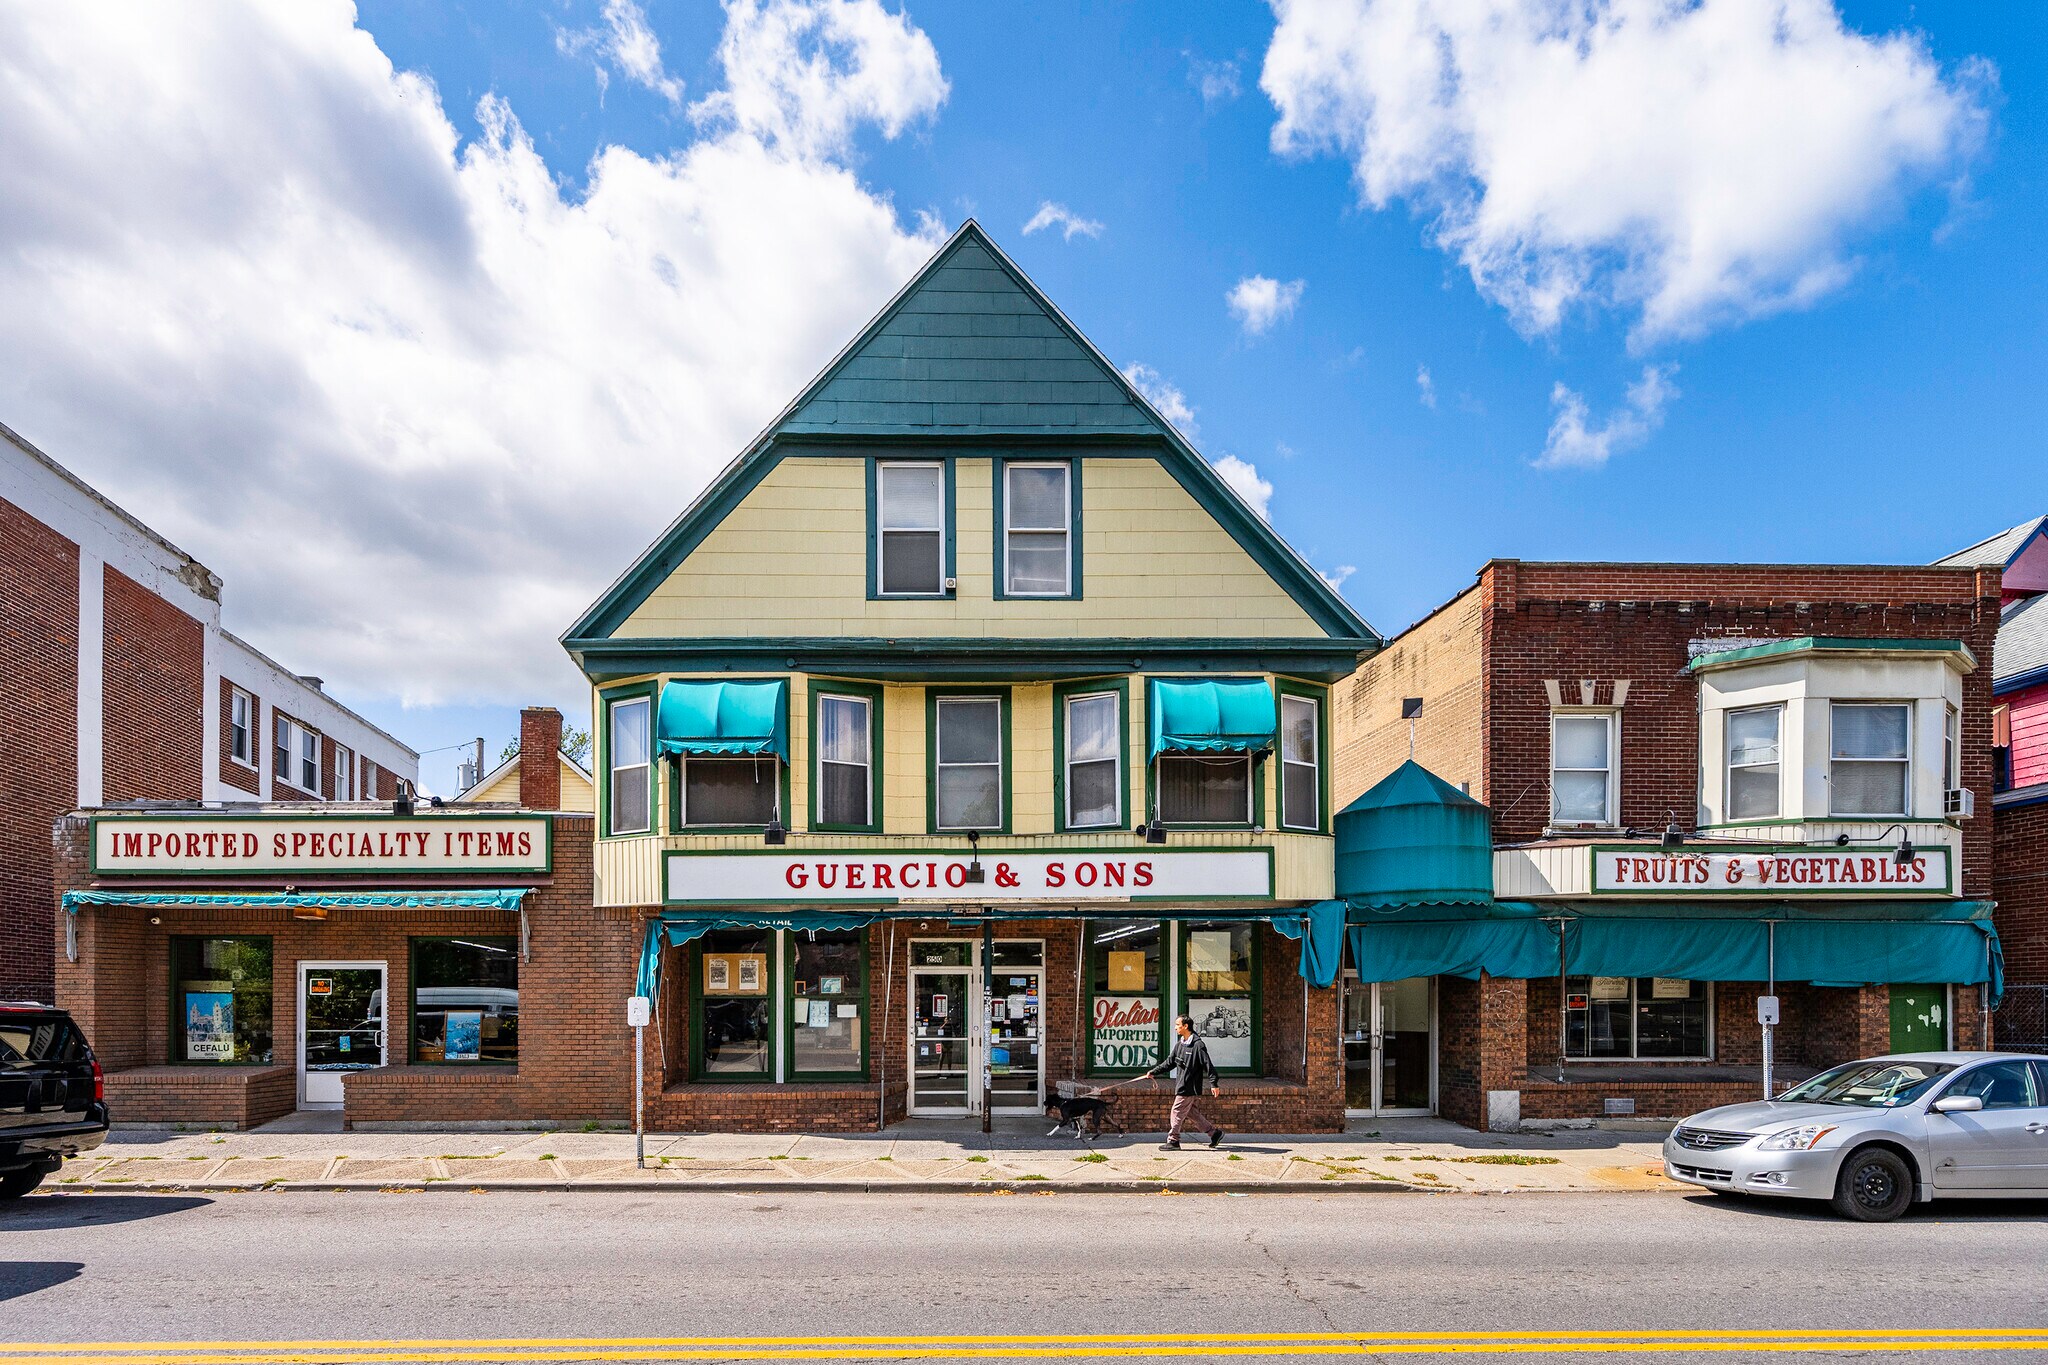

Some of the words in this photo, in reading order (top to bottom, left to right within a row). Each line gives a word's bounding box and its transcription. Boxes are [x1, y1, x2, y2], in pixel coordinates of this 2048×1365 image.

[111, 832, 259, 858] IMPORTED
[273, 832, 431, 858] SPECIALTY
[444, 831, 532, 857] ITEMS
[785, 862, 967, 889] GUERCIO
[994, 861, 1021, 888] &
[1046, 861, 1154, 888] SONS
[1615, 857, 1710, 884] FRUITS
[1725, 857, 1744, 884] &
[1757, 857, 1927, 884] VEGETABLES
[1094, 999, 1159, 1029] Italian
[193, 1042, 230, 1052] CEFALÙ
[1094, 1028, 1159, 1042] IMPORTED
[1094, 1044, 1159, 1067] FOODS
